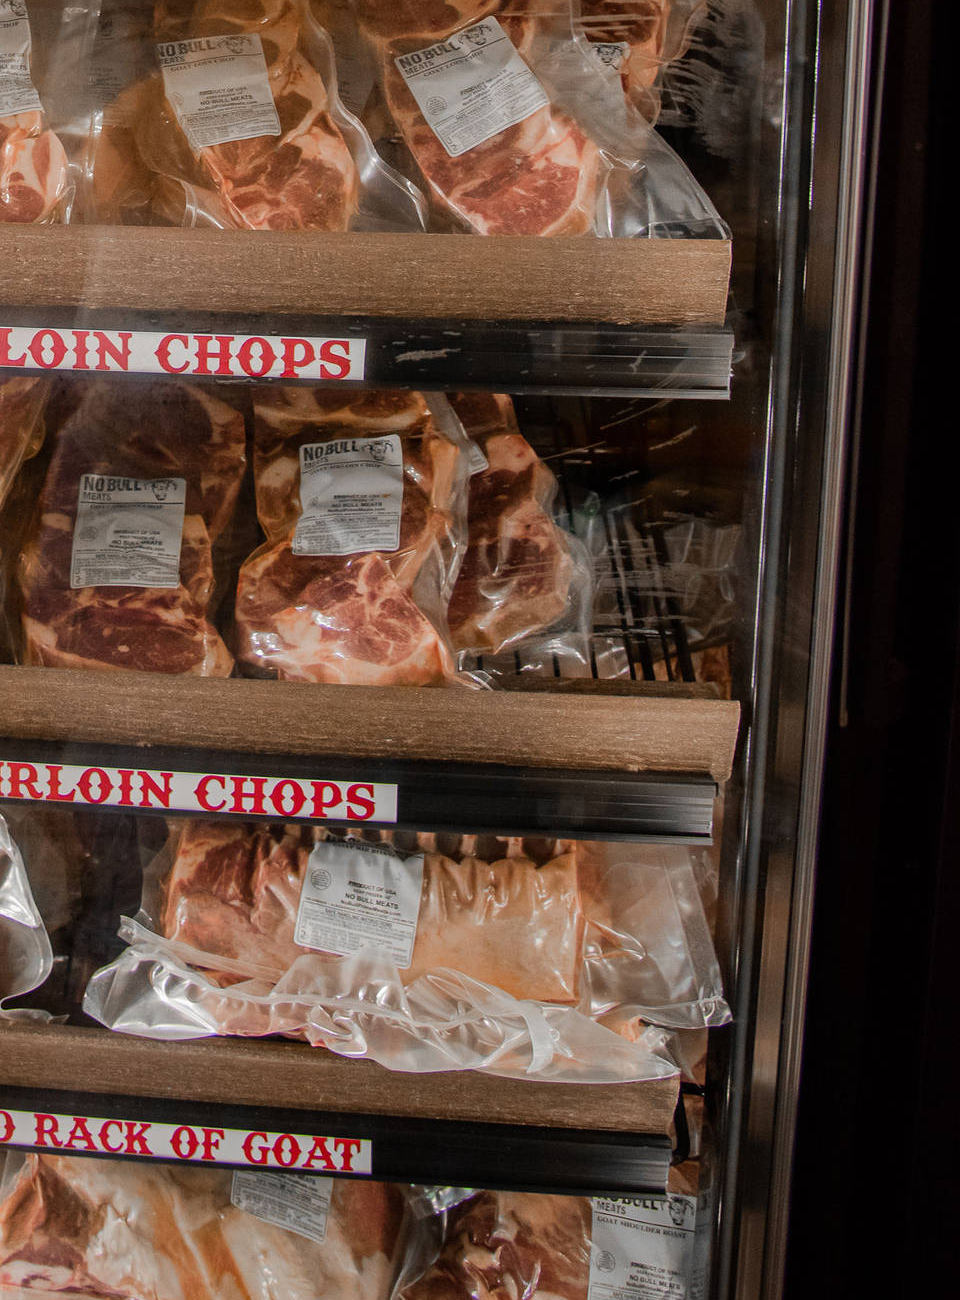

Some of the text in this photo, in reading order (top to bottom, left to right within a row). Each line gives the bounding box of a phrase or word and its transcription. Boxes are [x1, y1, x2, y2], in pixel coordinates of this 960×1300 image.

[179, 40, 216, 55] BULL
[398, 41, 461, 69] NO BULL
[154, 333, 351, 380] CHOPS
[303, 441, 359, 461] NO BULL
[83, 476, 142, 492] NO BULL
[194, 774, 376, 821] CHOPS
[34, 1113, 154, 1155] RACK
[170, 1125, 225, 1161] OF
[242, 1131, 361, 1172] GOAT
[596, 1200, 626, 1215] MEATS
